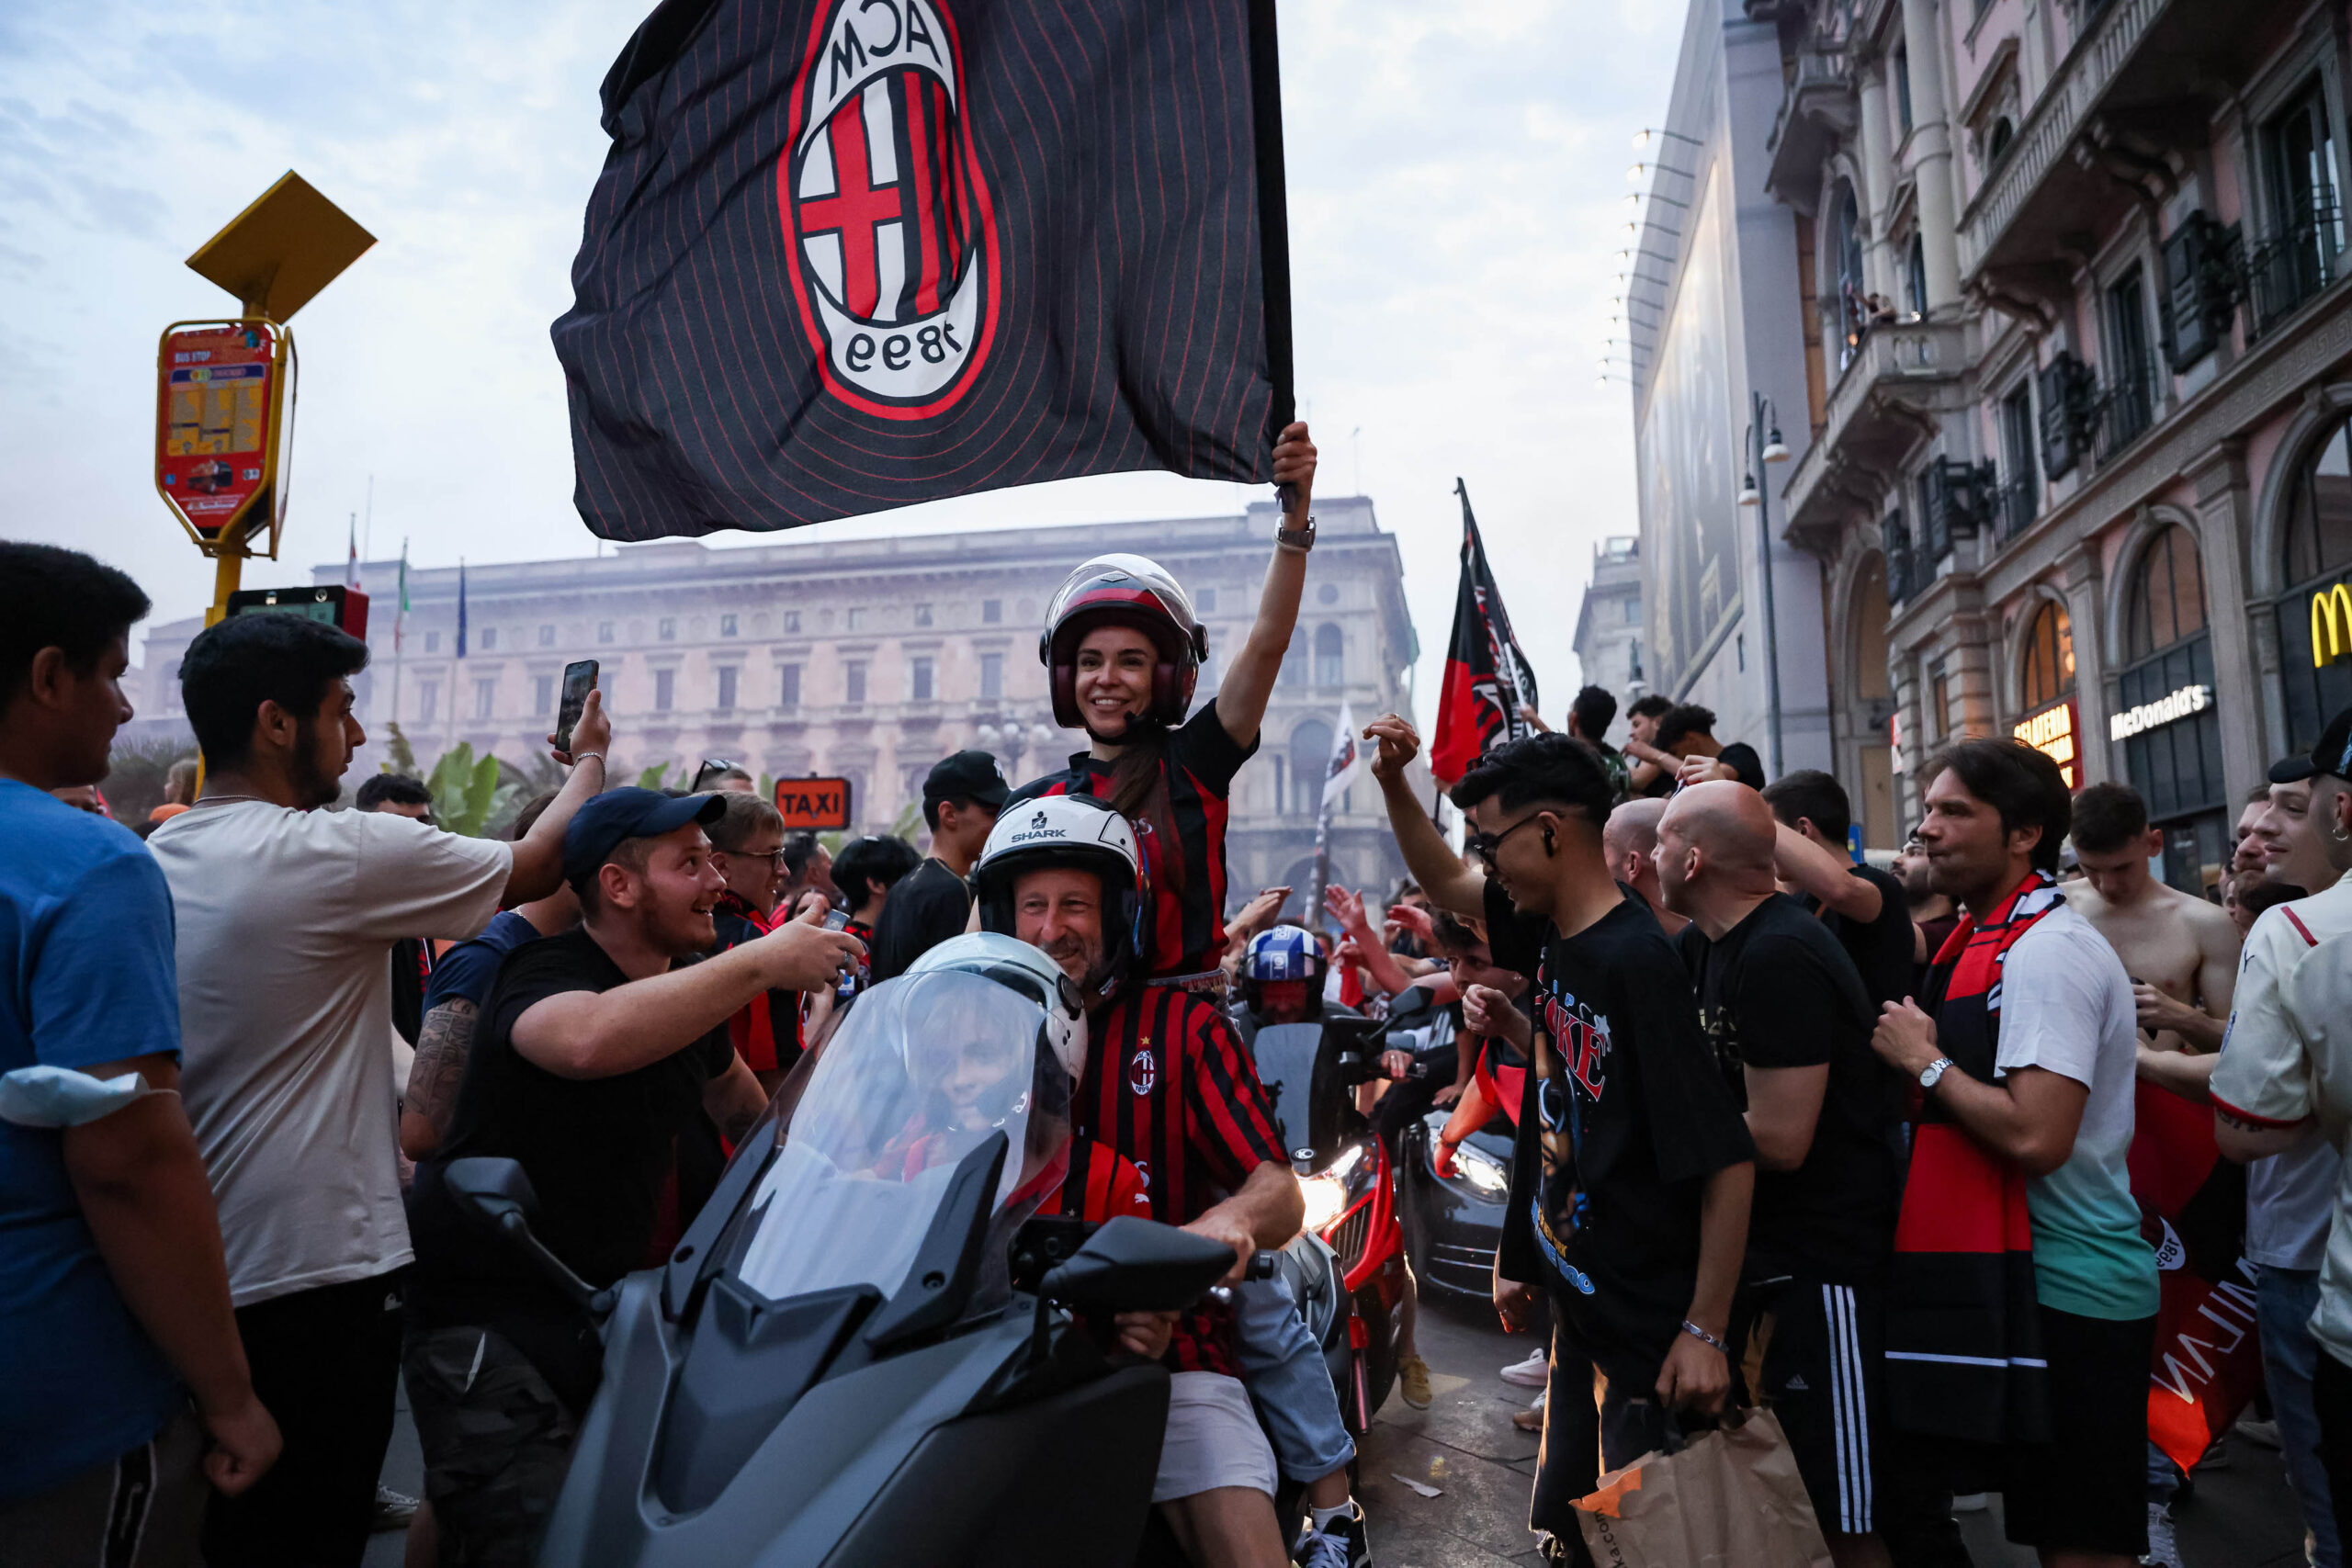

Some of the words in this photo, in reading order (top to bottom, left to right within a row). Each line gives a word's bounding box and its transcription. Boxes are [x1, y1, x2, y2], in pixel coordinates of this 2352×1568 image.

[2110, 684, 2206, 741] McDonald's
[781, 793, 840, 814] TAXI
[1012, 829, 1066, 842] SHARK
[1594, 1506, 1628, 1568] ka.com
